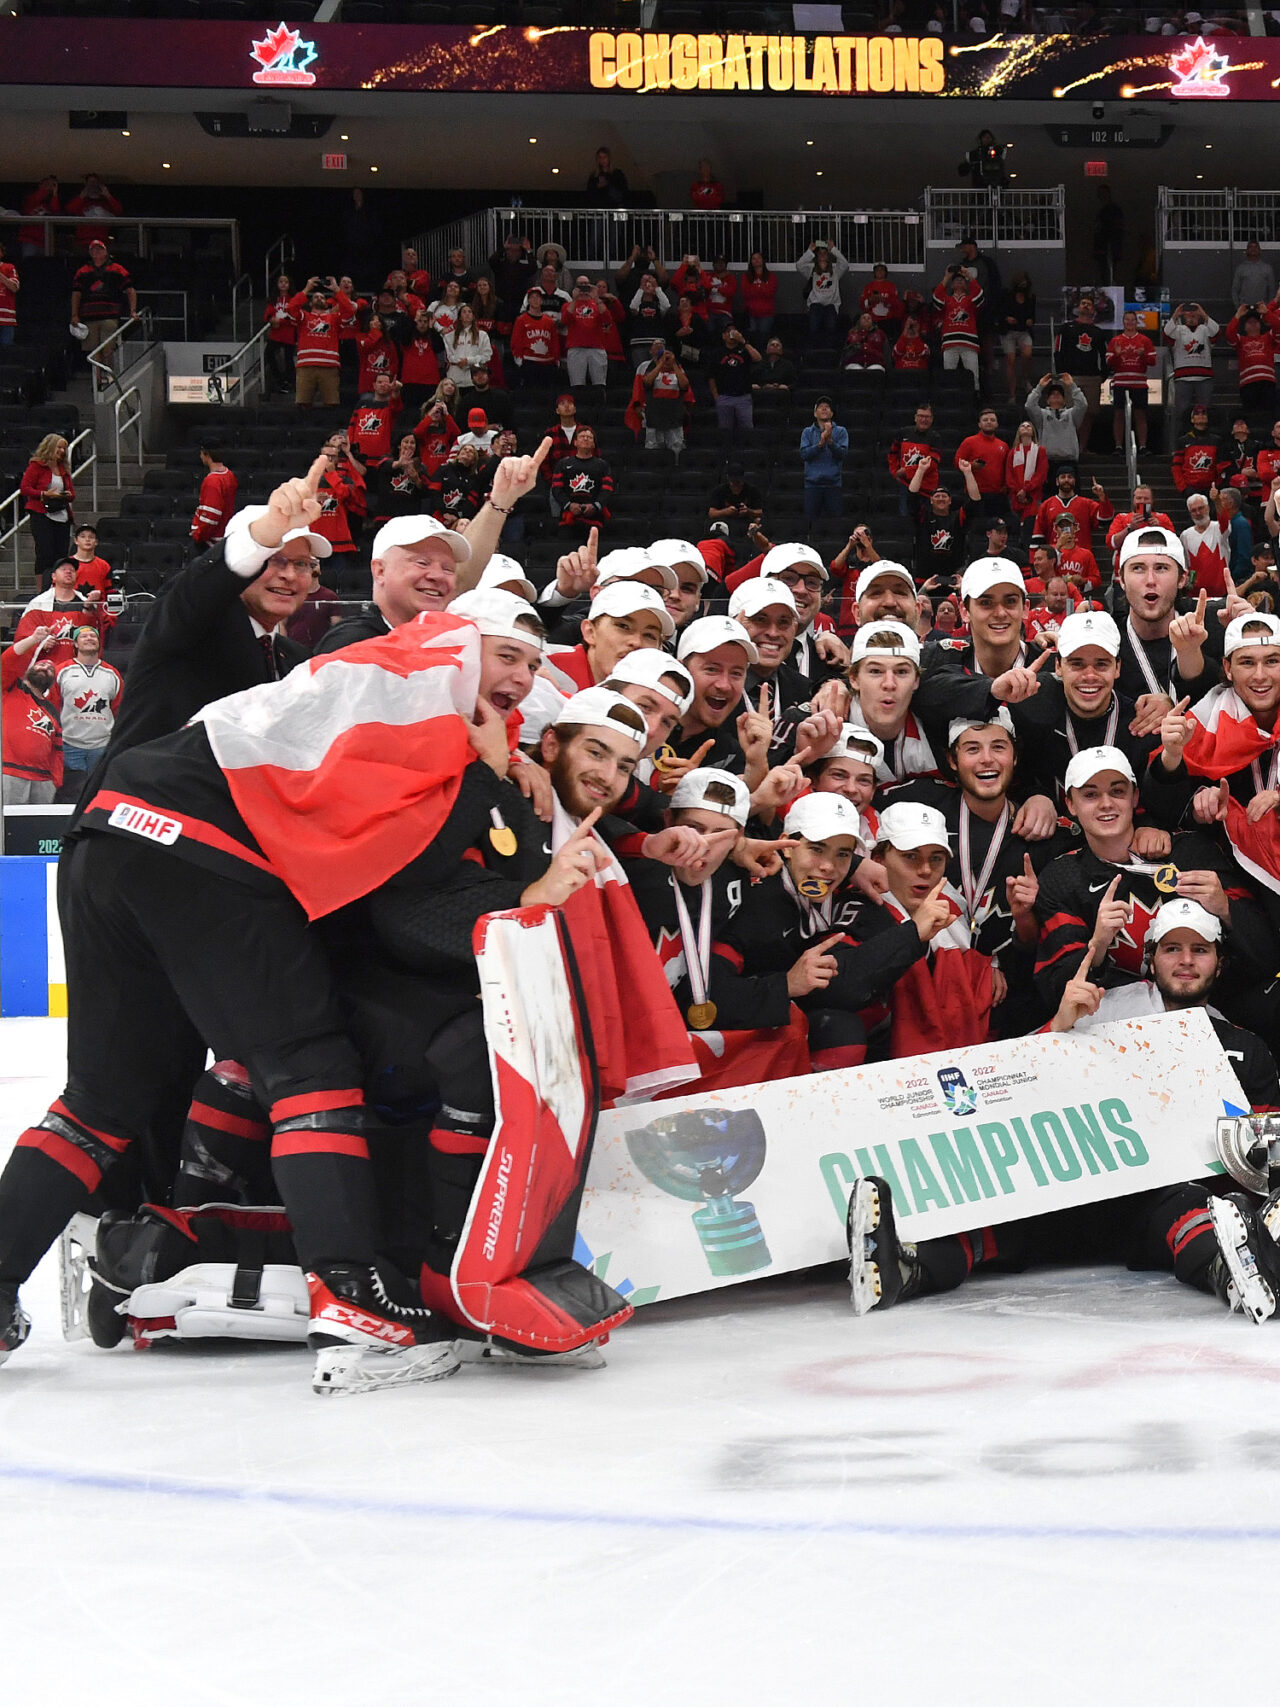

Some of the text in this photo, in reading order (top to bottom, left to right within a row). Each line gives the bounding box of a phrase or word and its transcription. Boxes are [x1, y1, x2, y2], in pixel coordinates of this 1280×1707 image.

[589, 32, 944, 93] CONGRATULATIONS
[1091, 131, 1107, 142] 102
[325, 154, 344, 168] EXIT
[127, 810, 175, 838] IIHF
[940, 1071, 961, 1083] IIHF
[971, 1065, 996, 1077] 2022
[905, 1077, 929, 1089] 2022
[976, 1071, 1028, 1086] CHAMPIONNAT
[978, 1076, 1038, 1092] MONDIAL JUNIOR
[877, 1089, 933, 1104] WORLD JUNIOR
[981, 1088, 1009, 1099] CANADA
[880, 1095, 935, 1110] CHAMPIONSHIP
[910, 1102, 938, 1112] CANADA
[984, 1096, 1013, 1106] Edmonton
[912, 1109, 942, 1119] Edmonton
[819, 1097, 1150, 1229] CHAMPIONS
[319, 1302, 411, 1345] CCM
